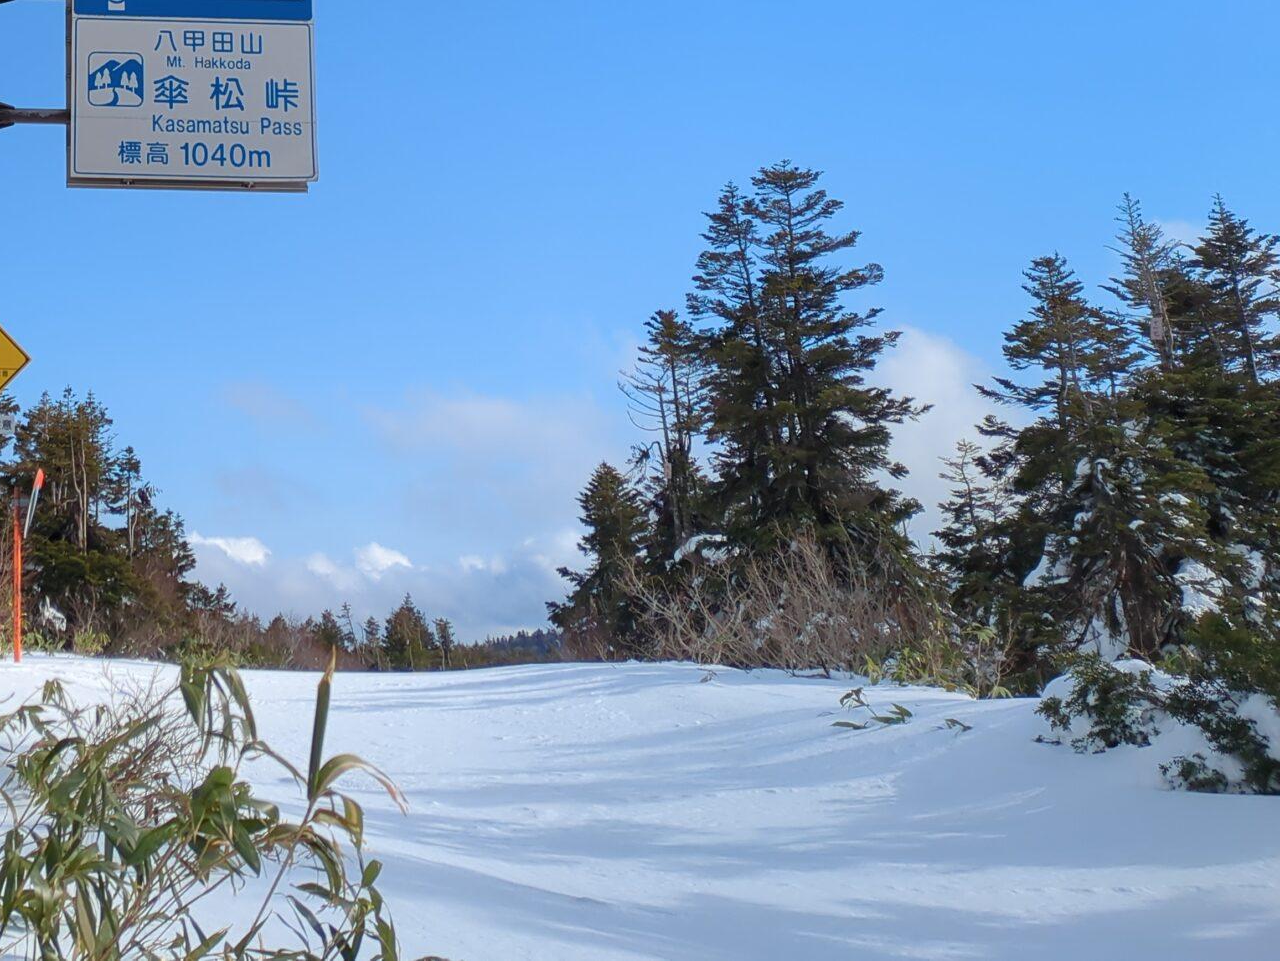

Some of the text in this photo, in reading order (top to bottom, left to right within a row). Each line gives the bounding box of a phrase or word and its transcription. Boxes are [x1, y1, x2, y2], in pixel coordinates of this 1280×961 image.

[154, 30, 262, 54] 八甲田山
[167, 56, 251, 70] Mt. Hakkoda
[153, 75, 299, 112] 傘松峠
[152, 115, 302, 136] Kasamatsu Pass
[118, 141, 271, 168] 標高 1040m
